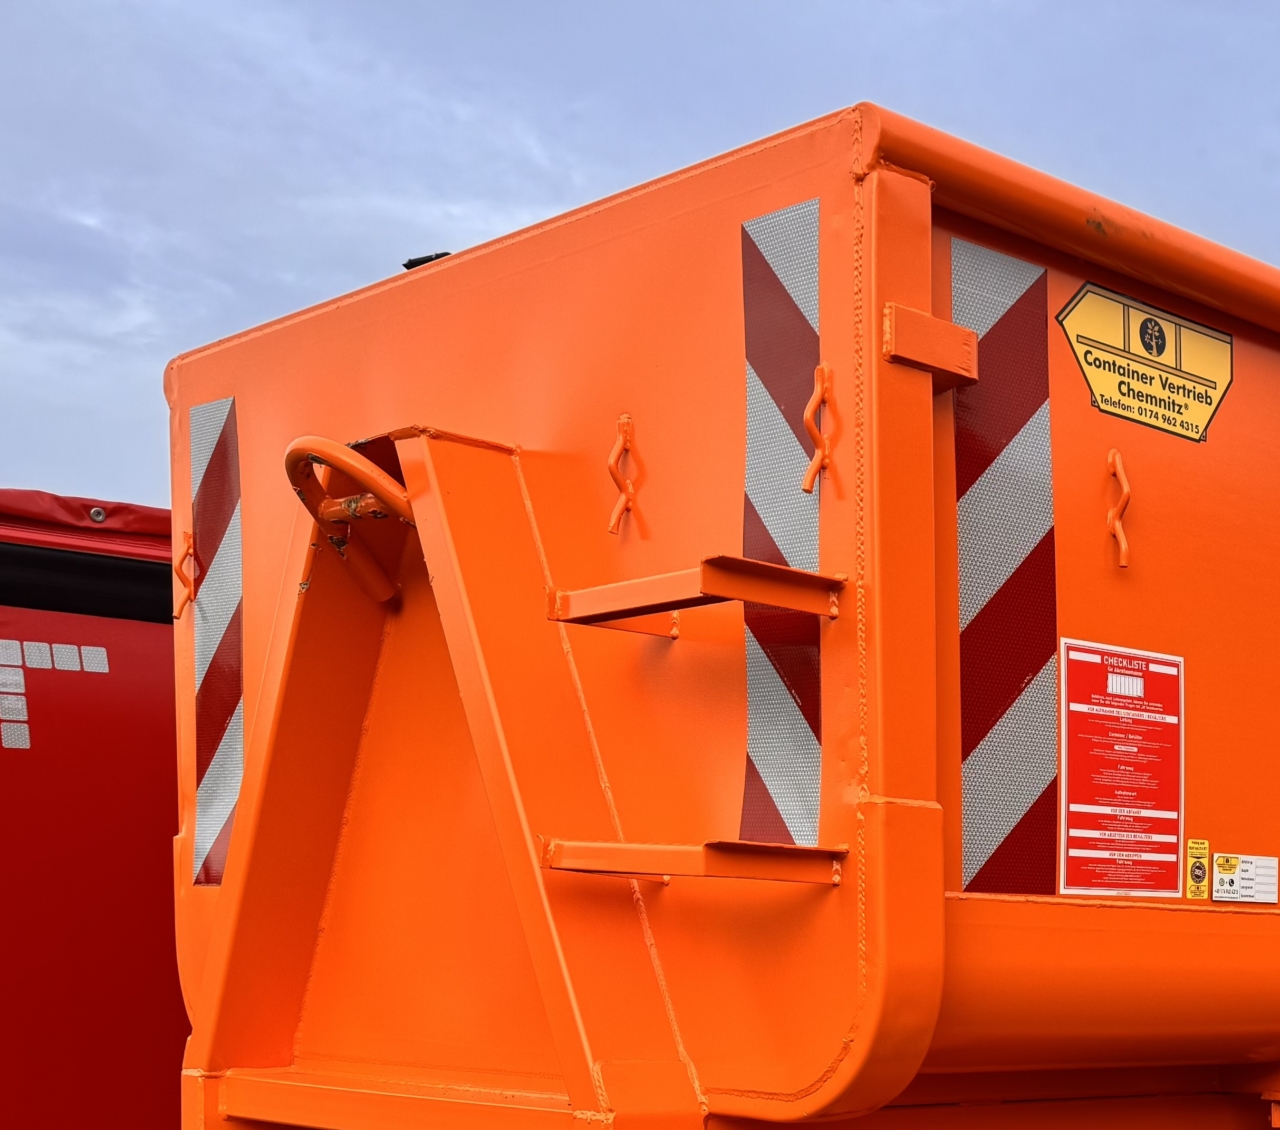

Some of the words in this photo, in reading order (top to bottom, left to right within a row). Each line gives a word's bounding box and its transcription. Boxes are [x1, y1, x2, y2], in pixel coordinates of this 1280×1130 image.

[1083, 350, 1155, 386] Container
[1158, 373, 1213, 406] Vertrieb
[1099, 393, 1135, 414] Telefon:
[1137, 405, 1159, 421] 0174
[1161, 412, 1177, 427] 962
[1179, 419, 1200, 434] 4315
[1103, 655, 1147, 671] CHECKLISTE
